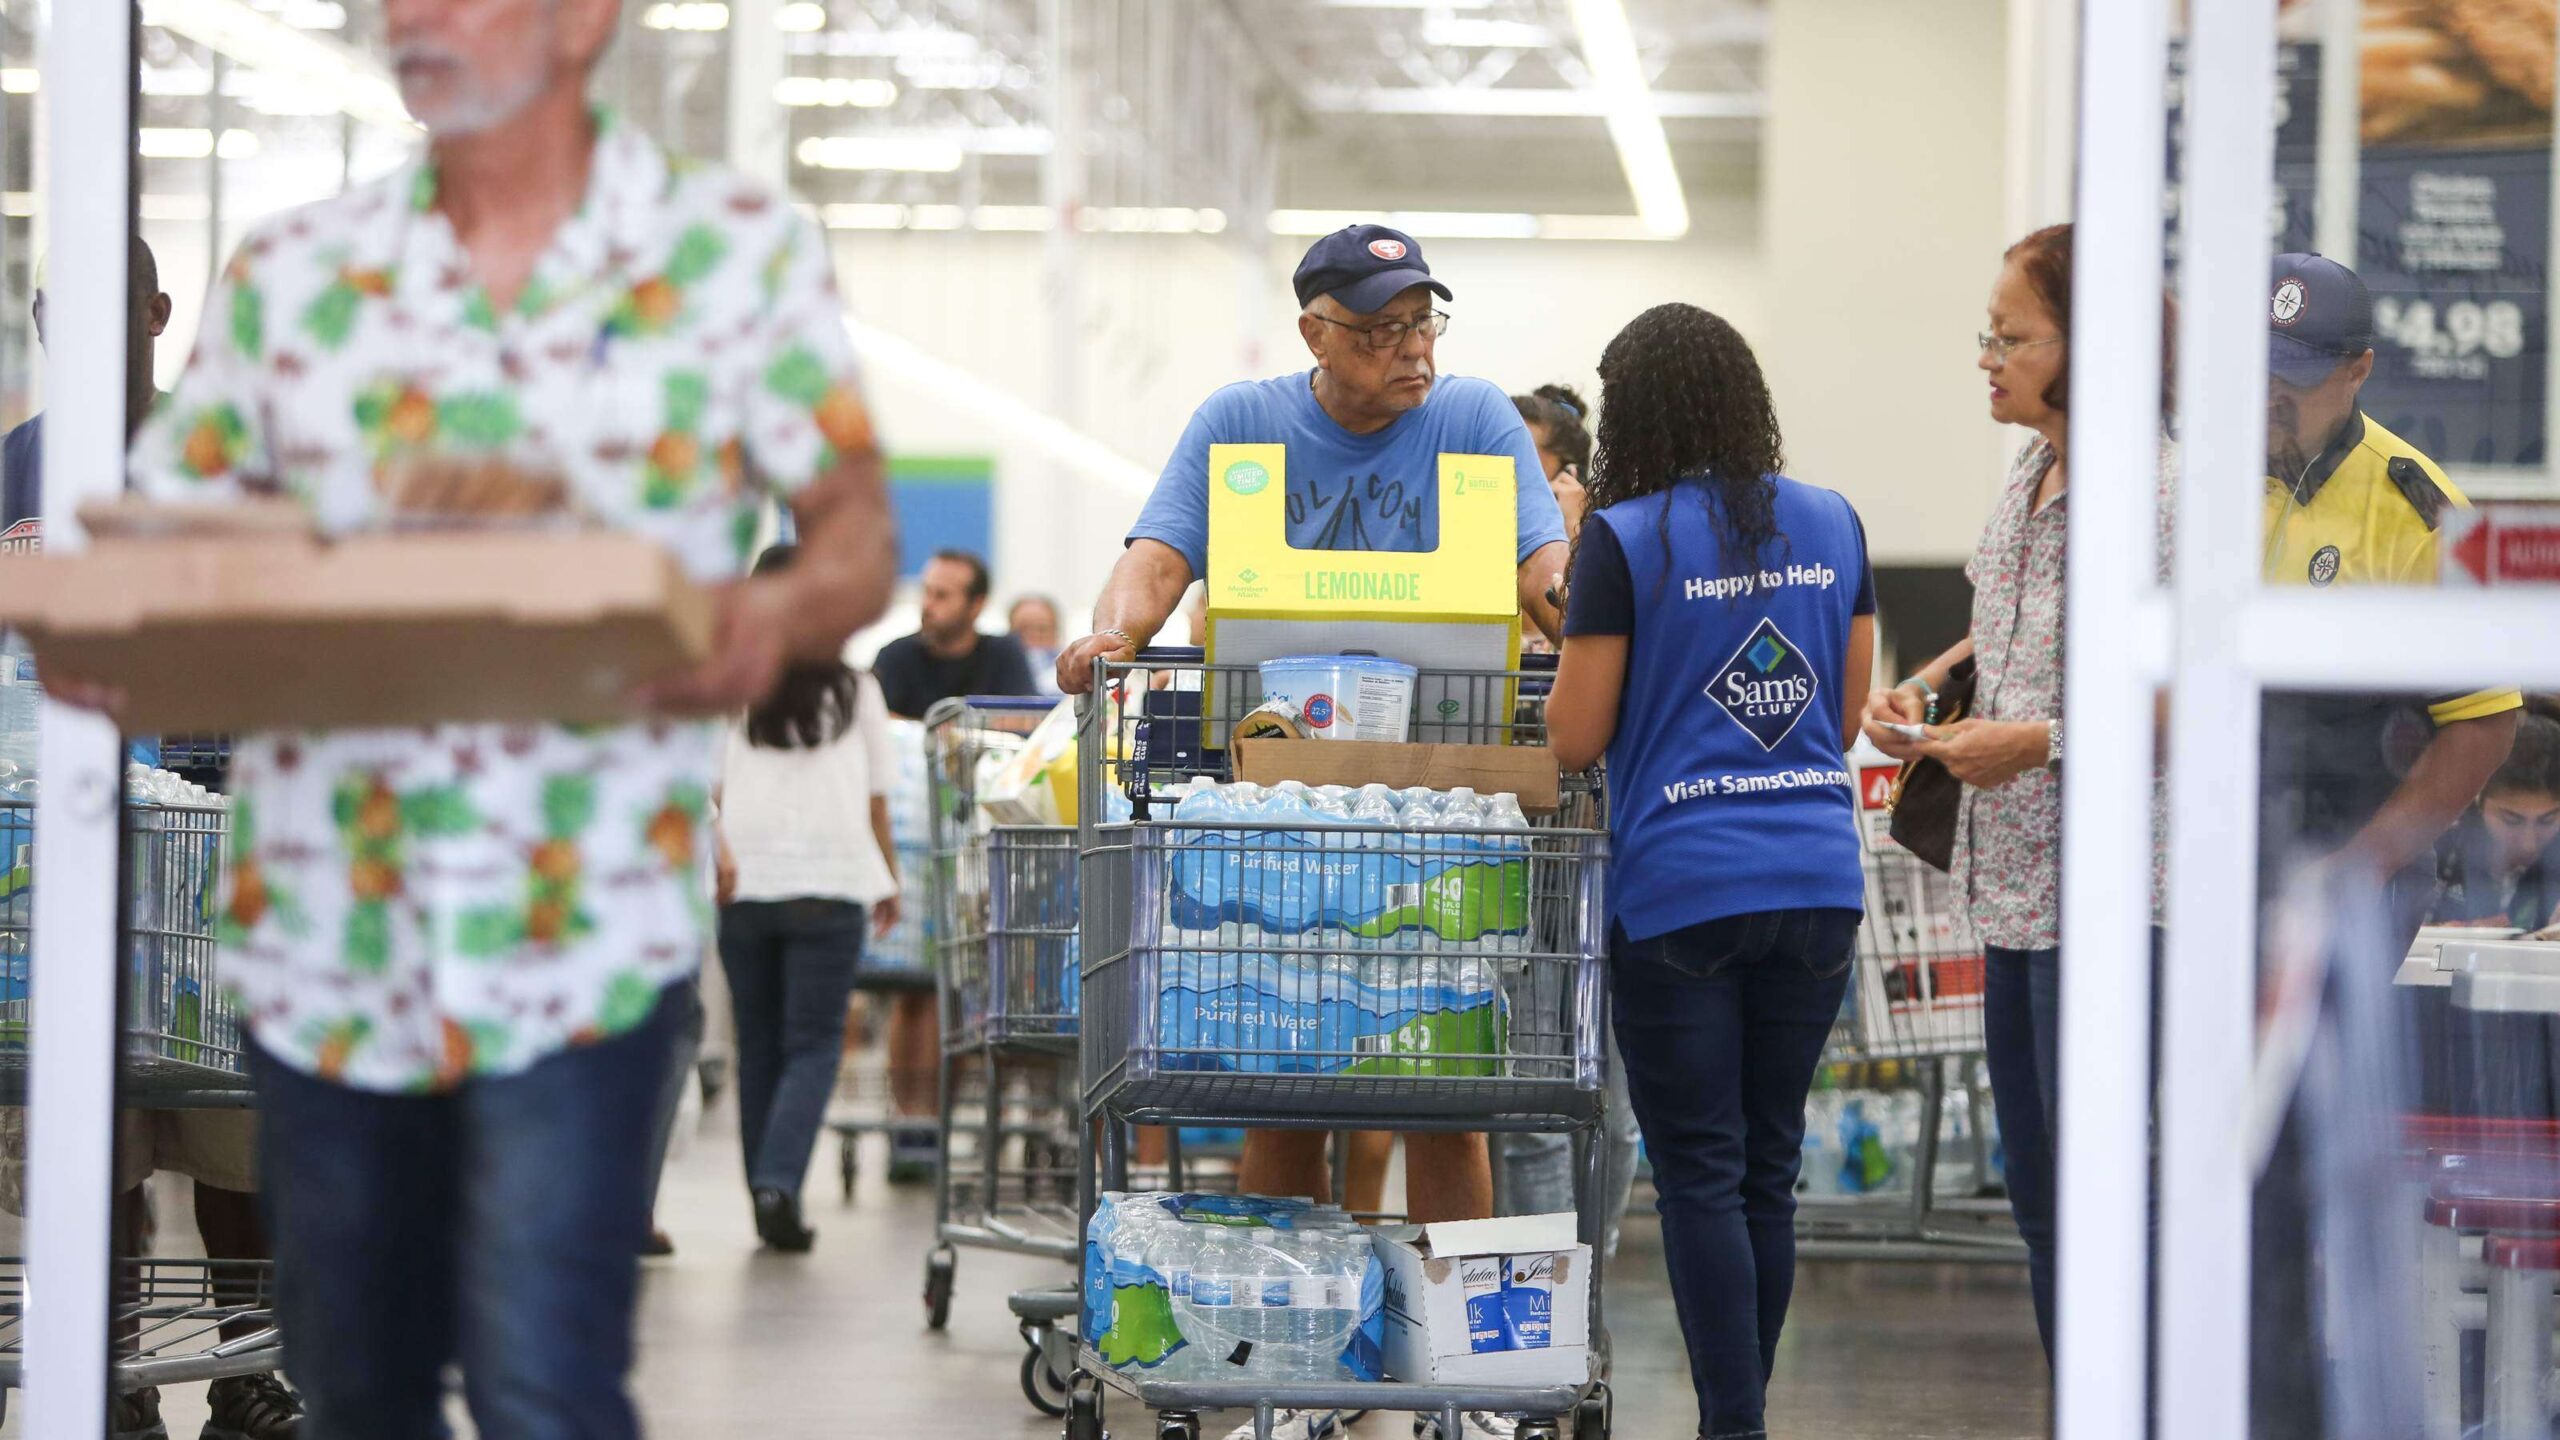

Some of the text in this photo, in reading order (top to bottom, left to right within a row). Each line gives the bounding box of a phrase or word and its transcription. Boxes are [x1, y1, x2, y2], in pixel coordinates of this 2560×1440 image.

[1455, 470, 1465, 496] 2
[2, 538, 42, 556] PUE
[1305, 571, 1421, 601] LEMONADE
[1685, 563, 1835, 600] Happy to Help
[1727, 671, 1808, 706] Sam's
[1746, 702, 1793, 717] CLUB
[1664, 778, 1717, 803] Visit
[1228, 853, 1360, 876] Purified Water
[1431, 875, 1463, 901] 40
[1194, 1006, 1266, 1026] Purifed
[1399, 1024, 1432, 1050] 40
